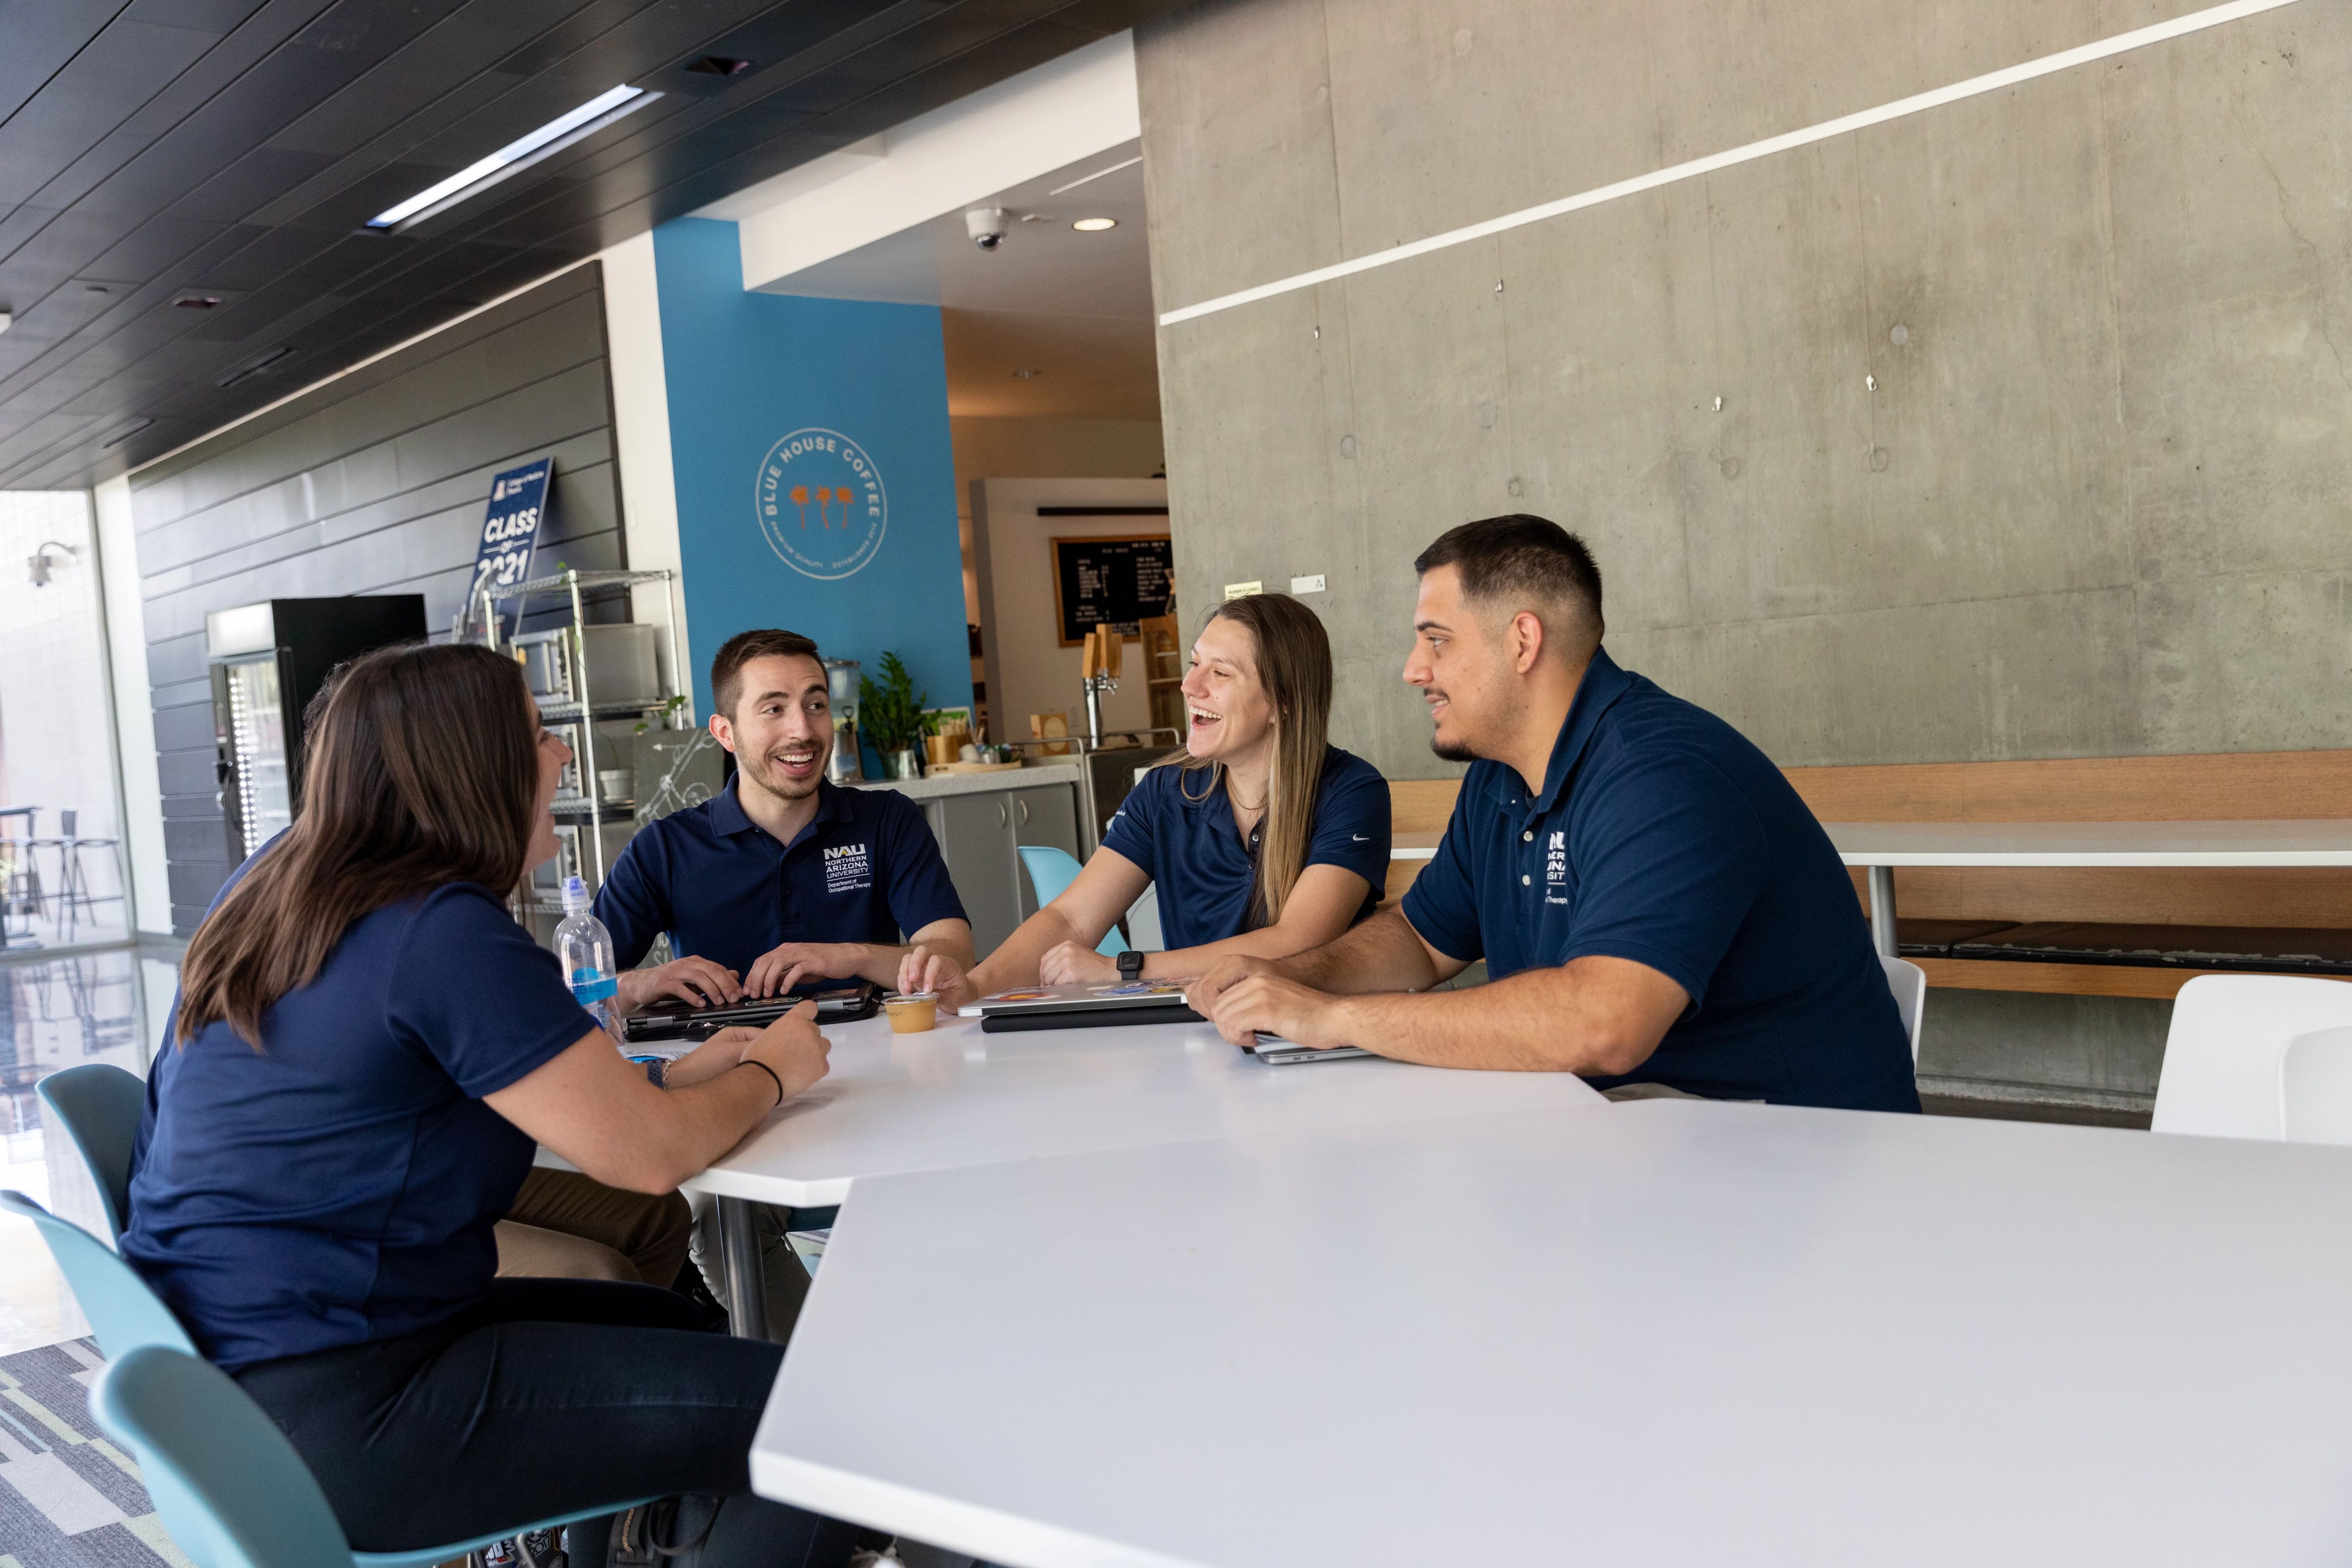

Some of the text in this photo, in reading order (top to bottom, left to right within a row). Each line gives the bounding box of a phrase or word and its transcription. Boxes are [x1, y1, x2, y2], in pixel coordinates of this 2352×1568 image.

[764, 437, 880, 517] BLUE HOUSE COFFEE
[484, 507, 538, 543] CLASS
[500, 540, 514, 554] OF
[823, 843, 866, 860] NAU
[825, 855, 866, 866] NORTHERN
[826, 861, 868, 873] ARIZONA
[827, 867, 868, 879] UNIVERSITY
